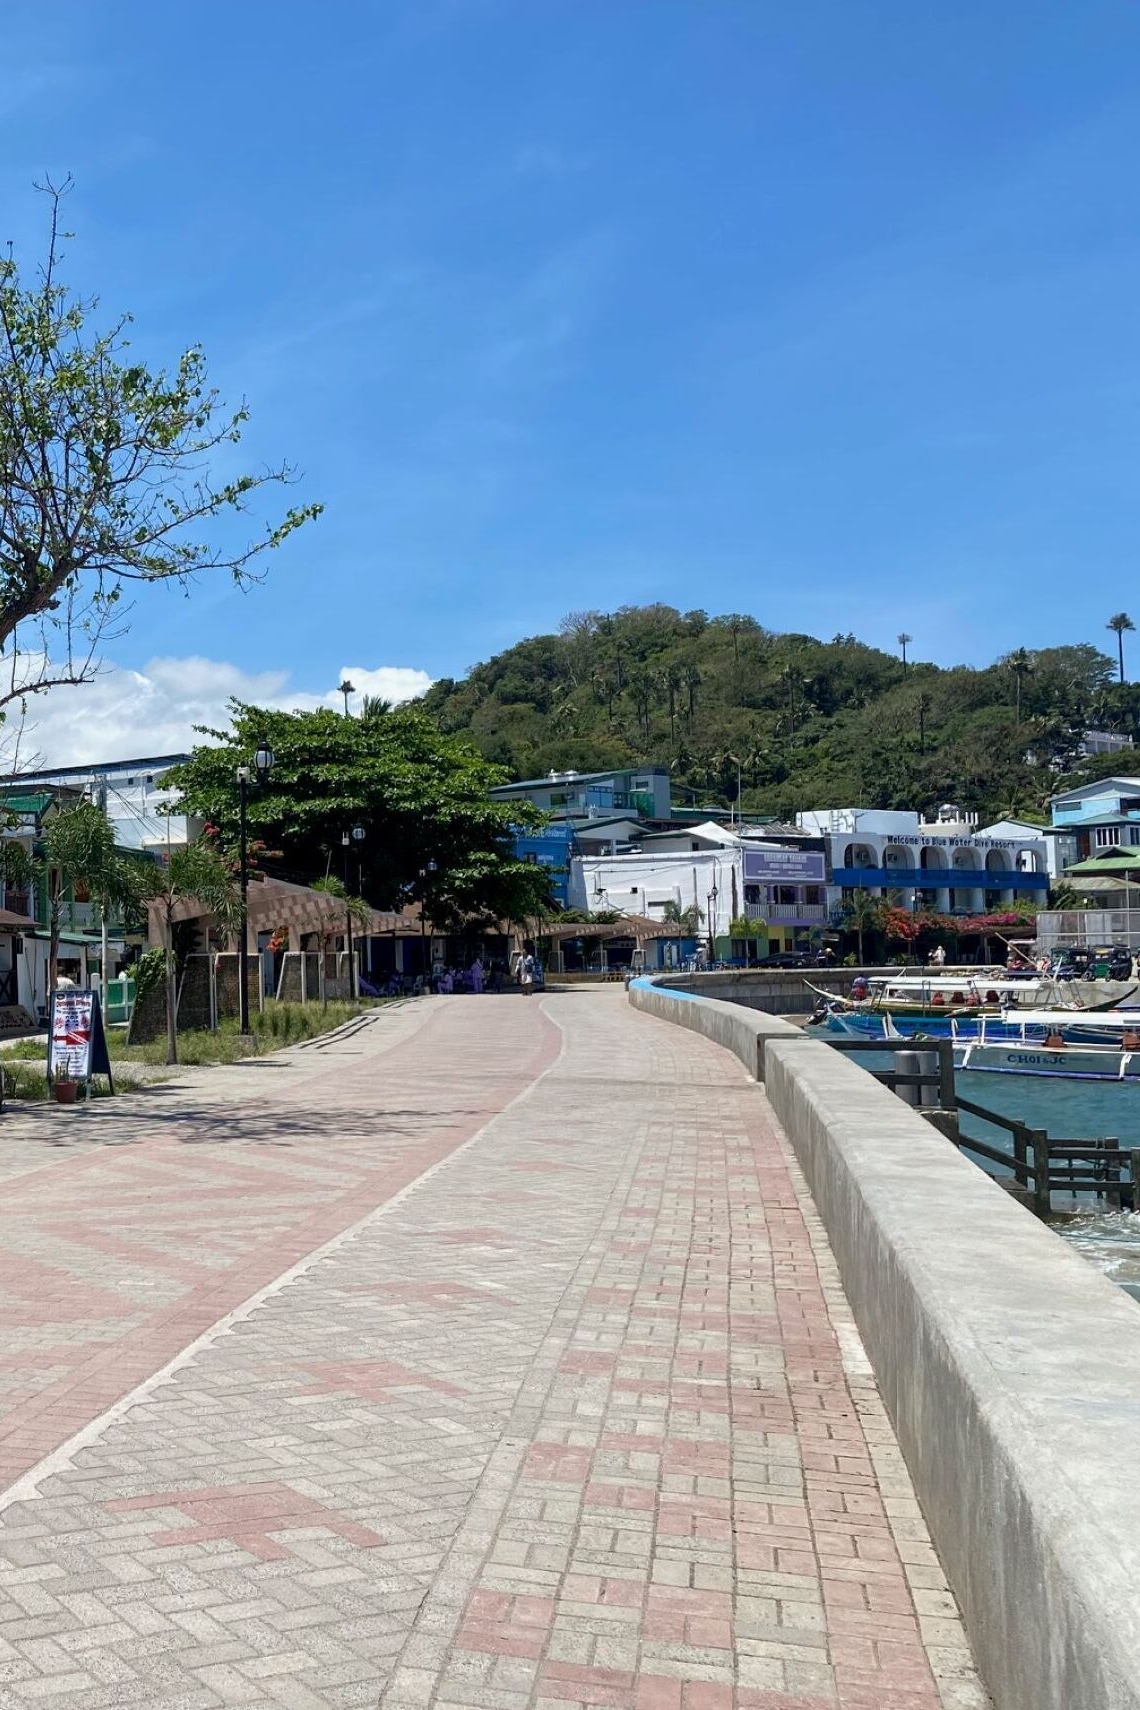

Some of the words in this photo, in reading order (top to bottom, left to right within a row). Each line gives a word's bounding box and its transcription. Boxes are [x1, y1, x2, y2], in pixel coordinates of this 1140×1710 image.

[887, 835, 919, 846] Welcome
[922, 837, 930, 846] to
[932, 838, 947, 847] Blue
[949, 838, 972, 847] Water
[991, 839, 1015, 849] Resort
